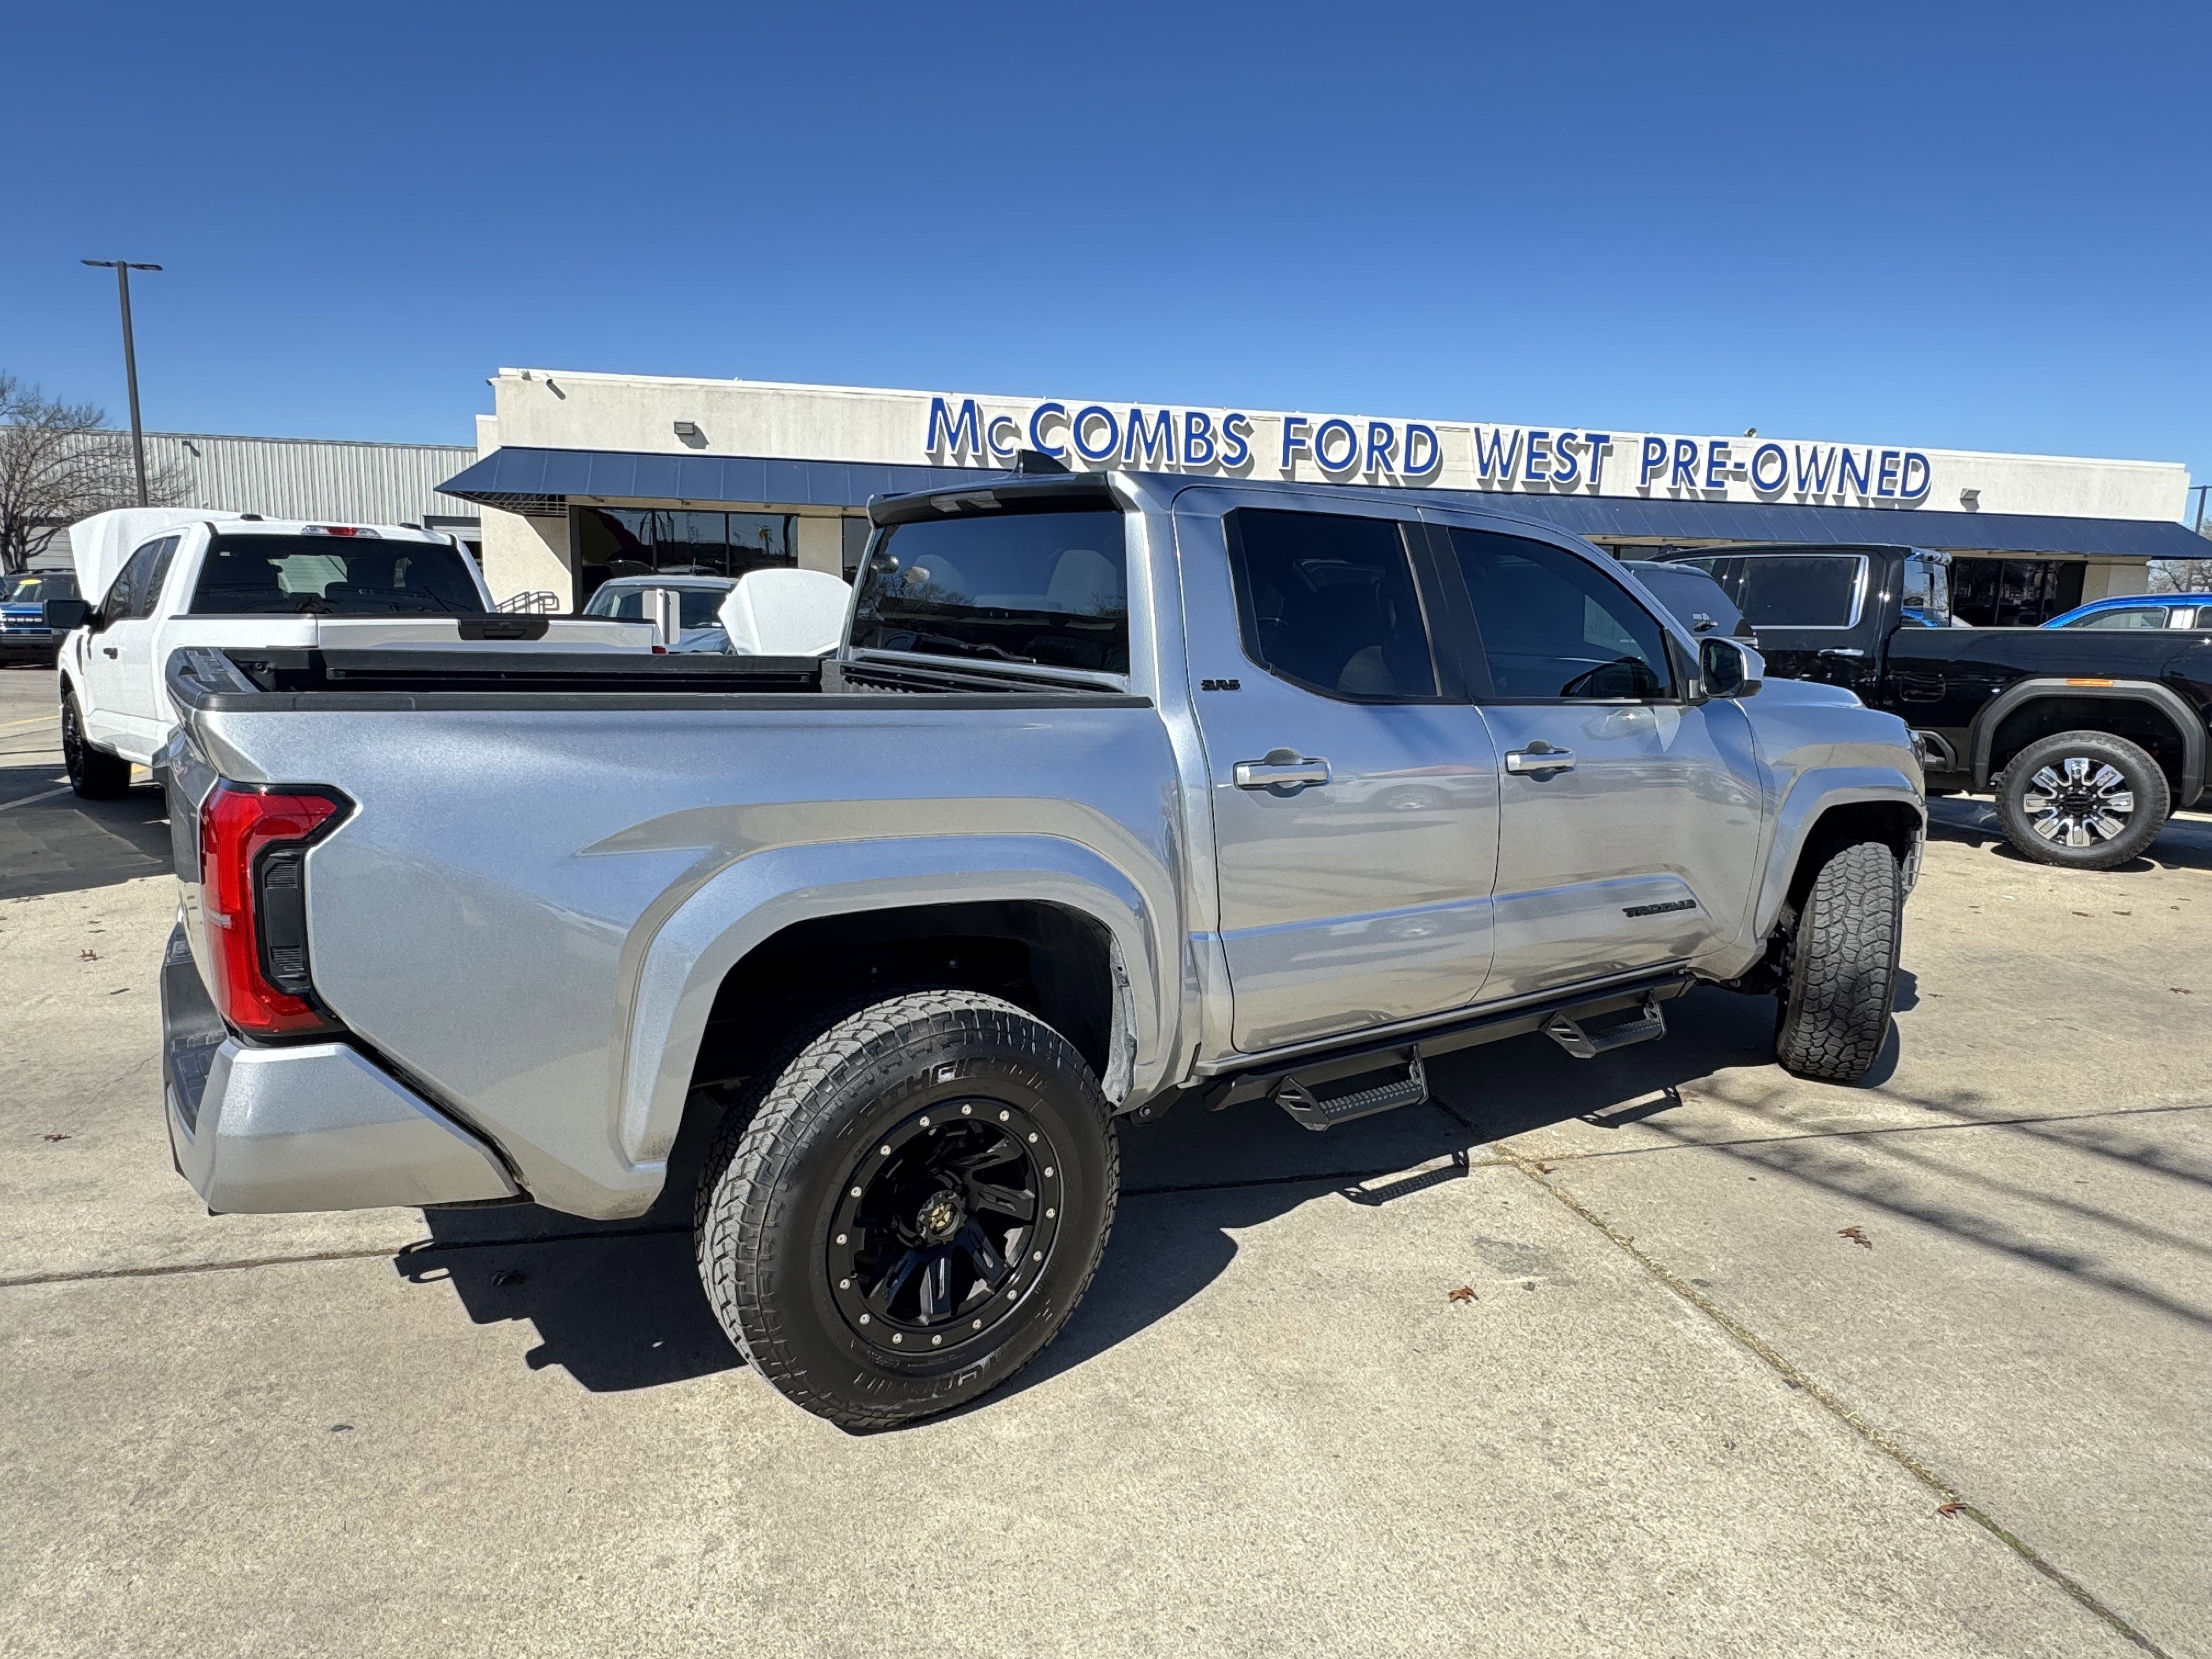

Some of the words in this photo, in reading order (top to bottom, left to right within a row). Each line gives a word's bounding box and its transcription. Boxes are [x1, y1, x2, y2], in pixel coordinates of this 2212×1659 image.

[926, 396, 1250, 466] McCOMBS
[1280, 416, 1441, 476] FORD
[1474, 426, 1612, 485] WEST
[1639, 436, 1932, 500] PRE-OWNED
